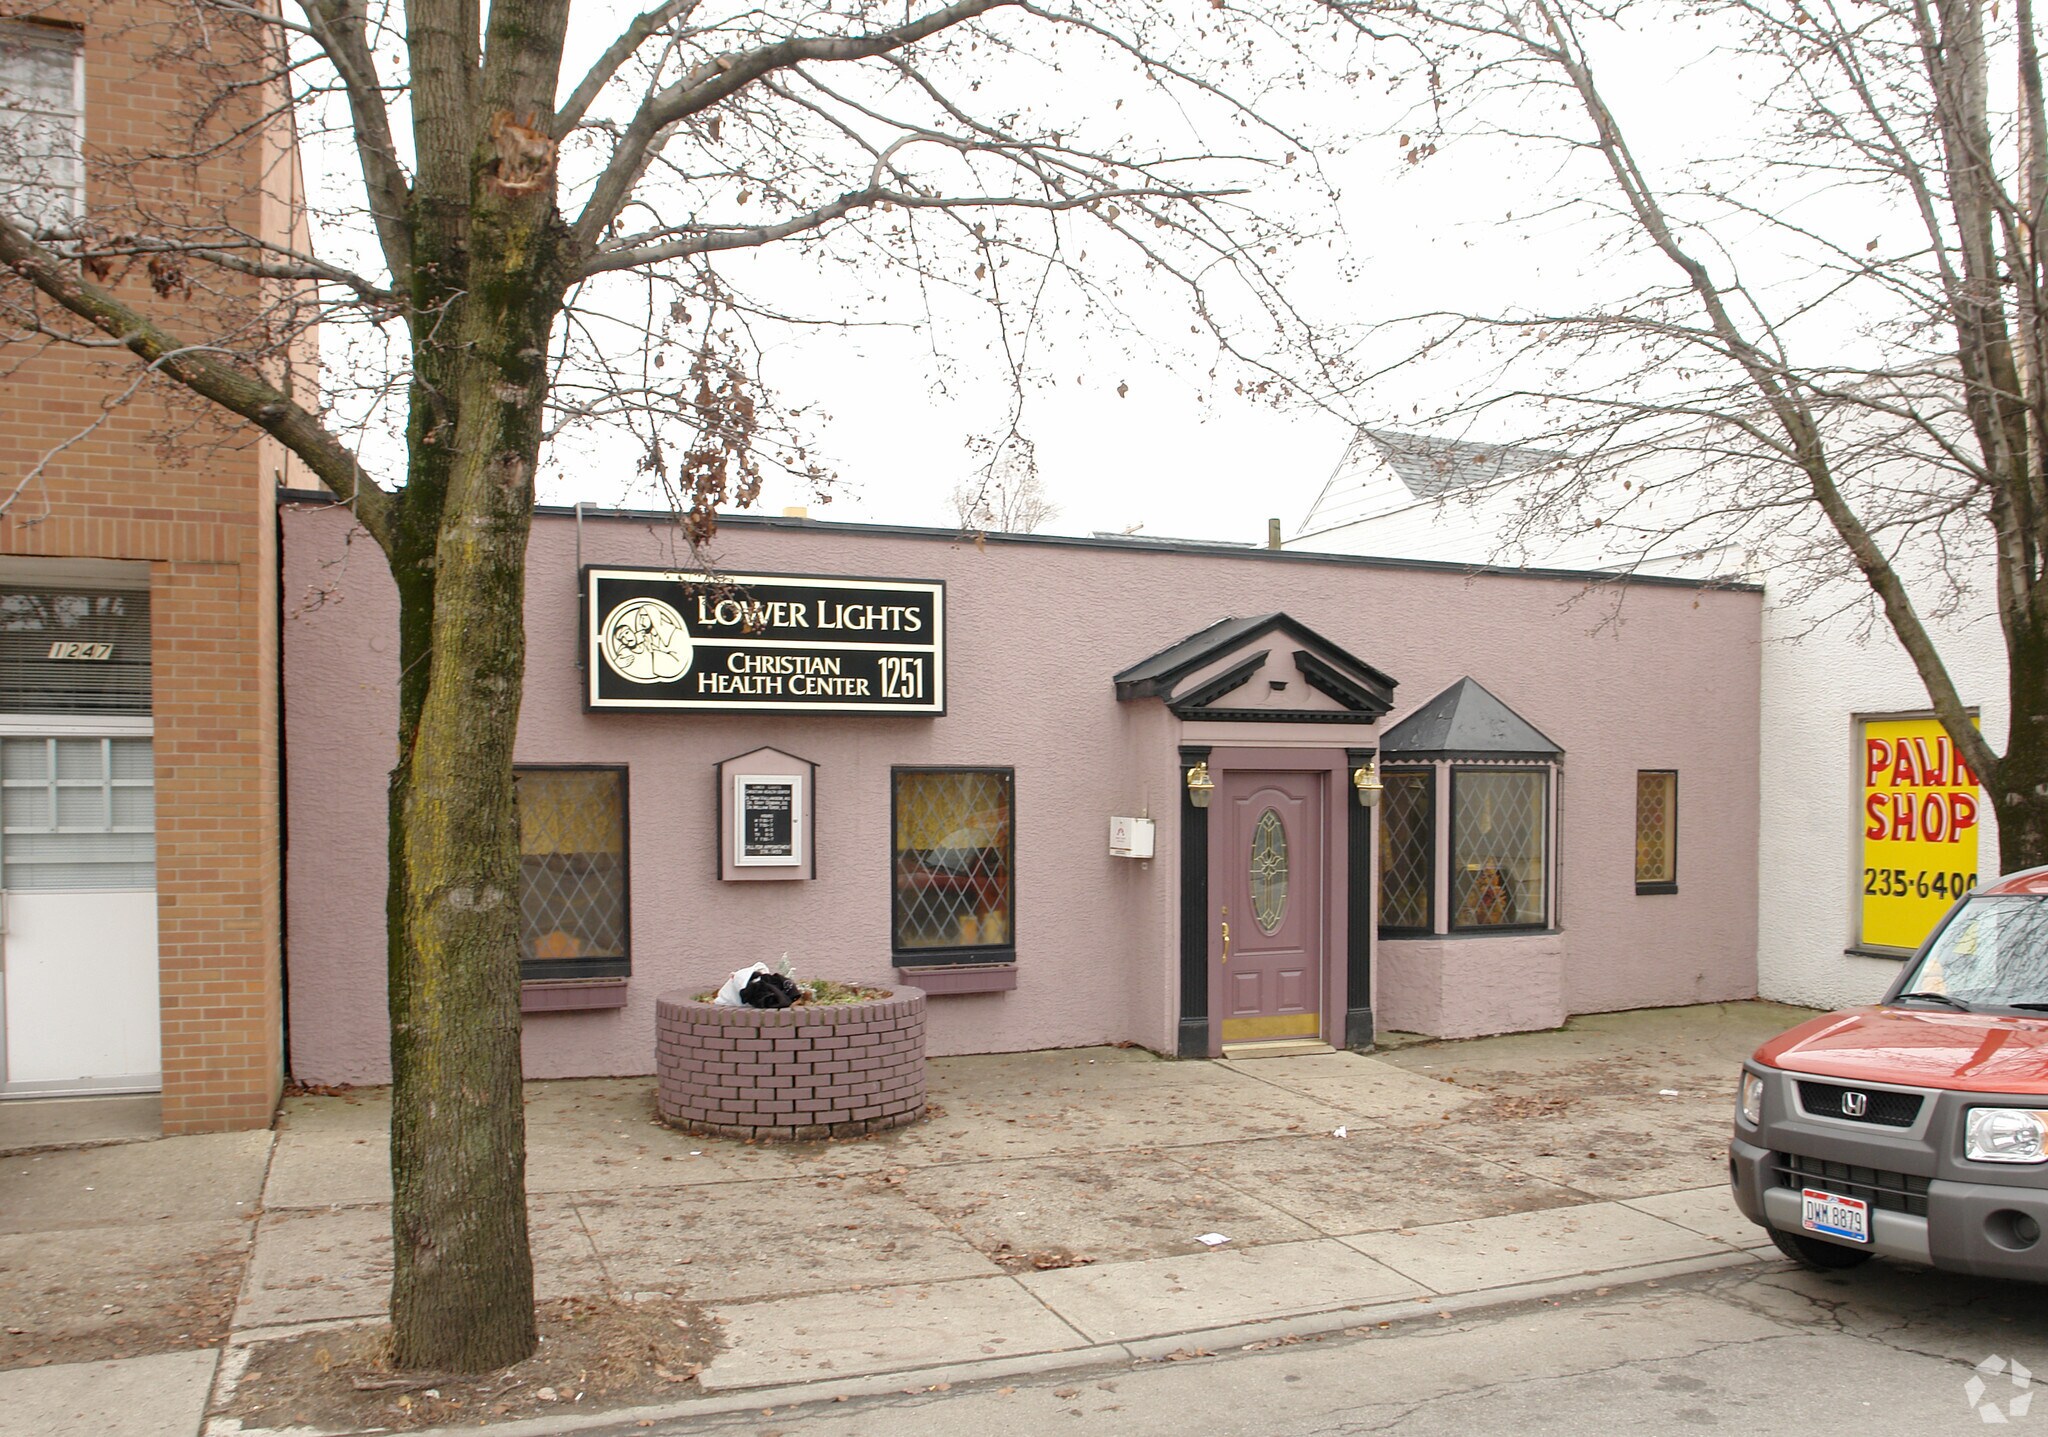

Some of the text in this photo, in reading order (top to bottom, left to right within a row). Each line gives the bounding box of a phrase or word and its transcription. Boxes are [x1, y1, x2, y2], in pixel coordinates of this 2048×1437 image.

[697, 595, 922, 633] LOWER LIGHTS
[55, 644, 110, 658] 1247
[727, 652, 841, 675] CHRISTIAN
[698, 672, 870, 697] HEALTH CENTER
[878, 656, 924, 699] 1251
[1866, 792, 1979, 843] SHOP
[1833, 1207, 1861, 1231] 8879
